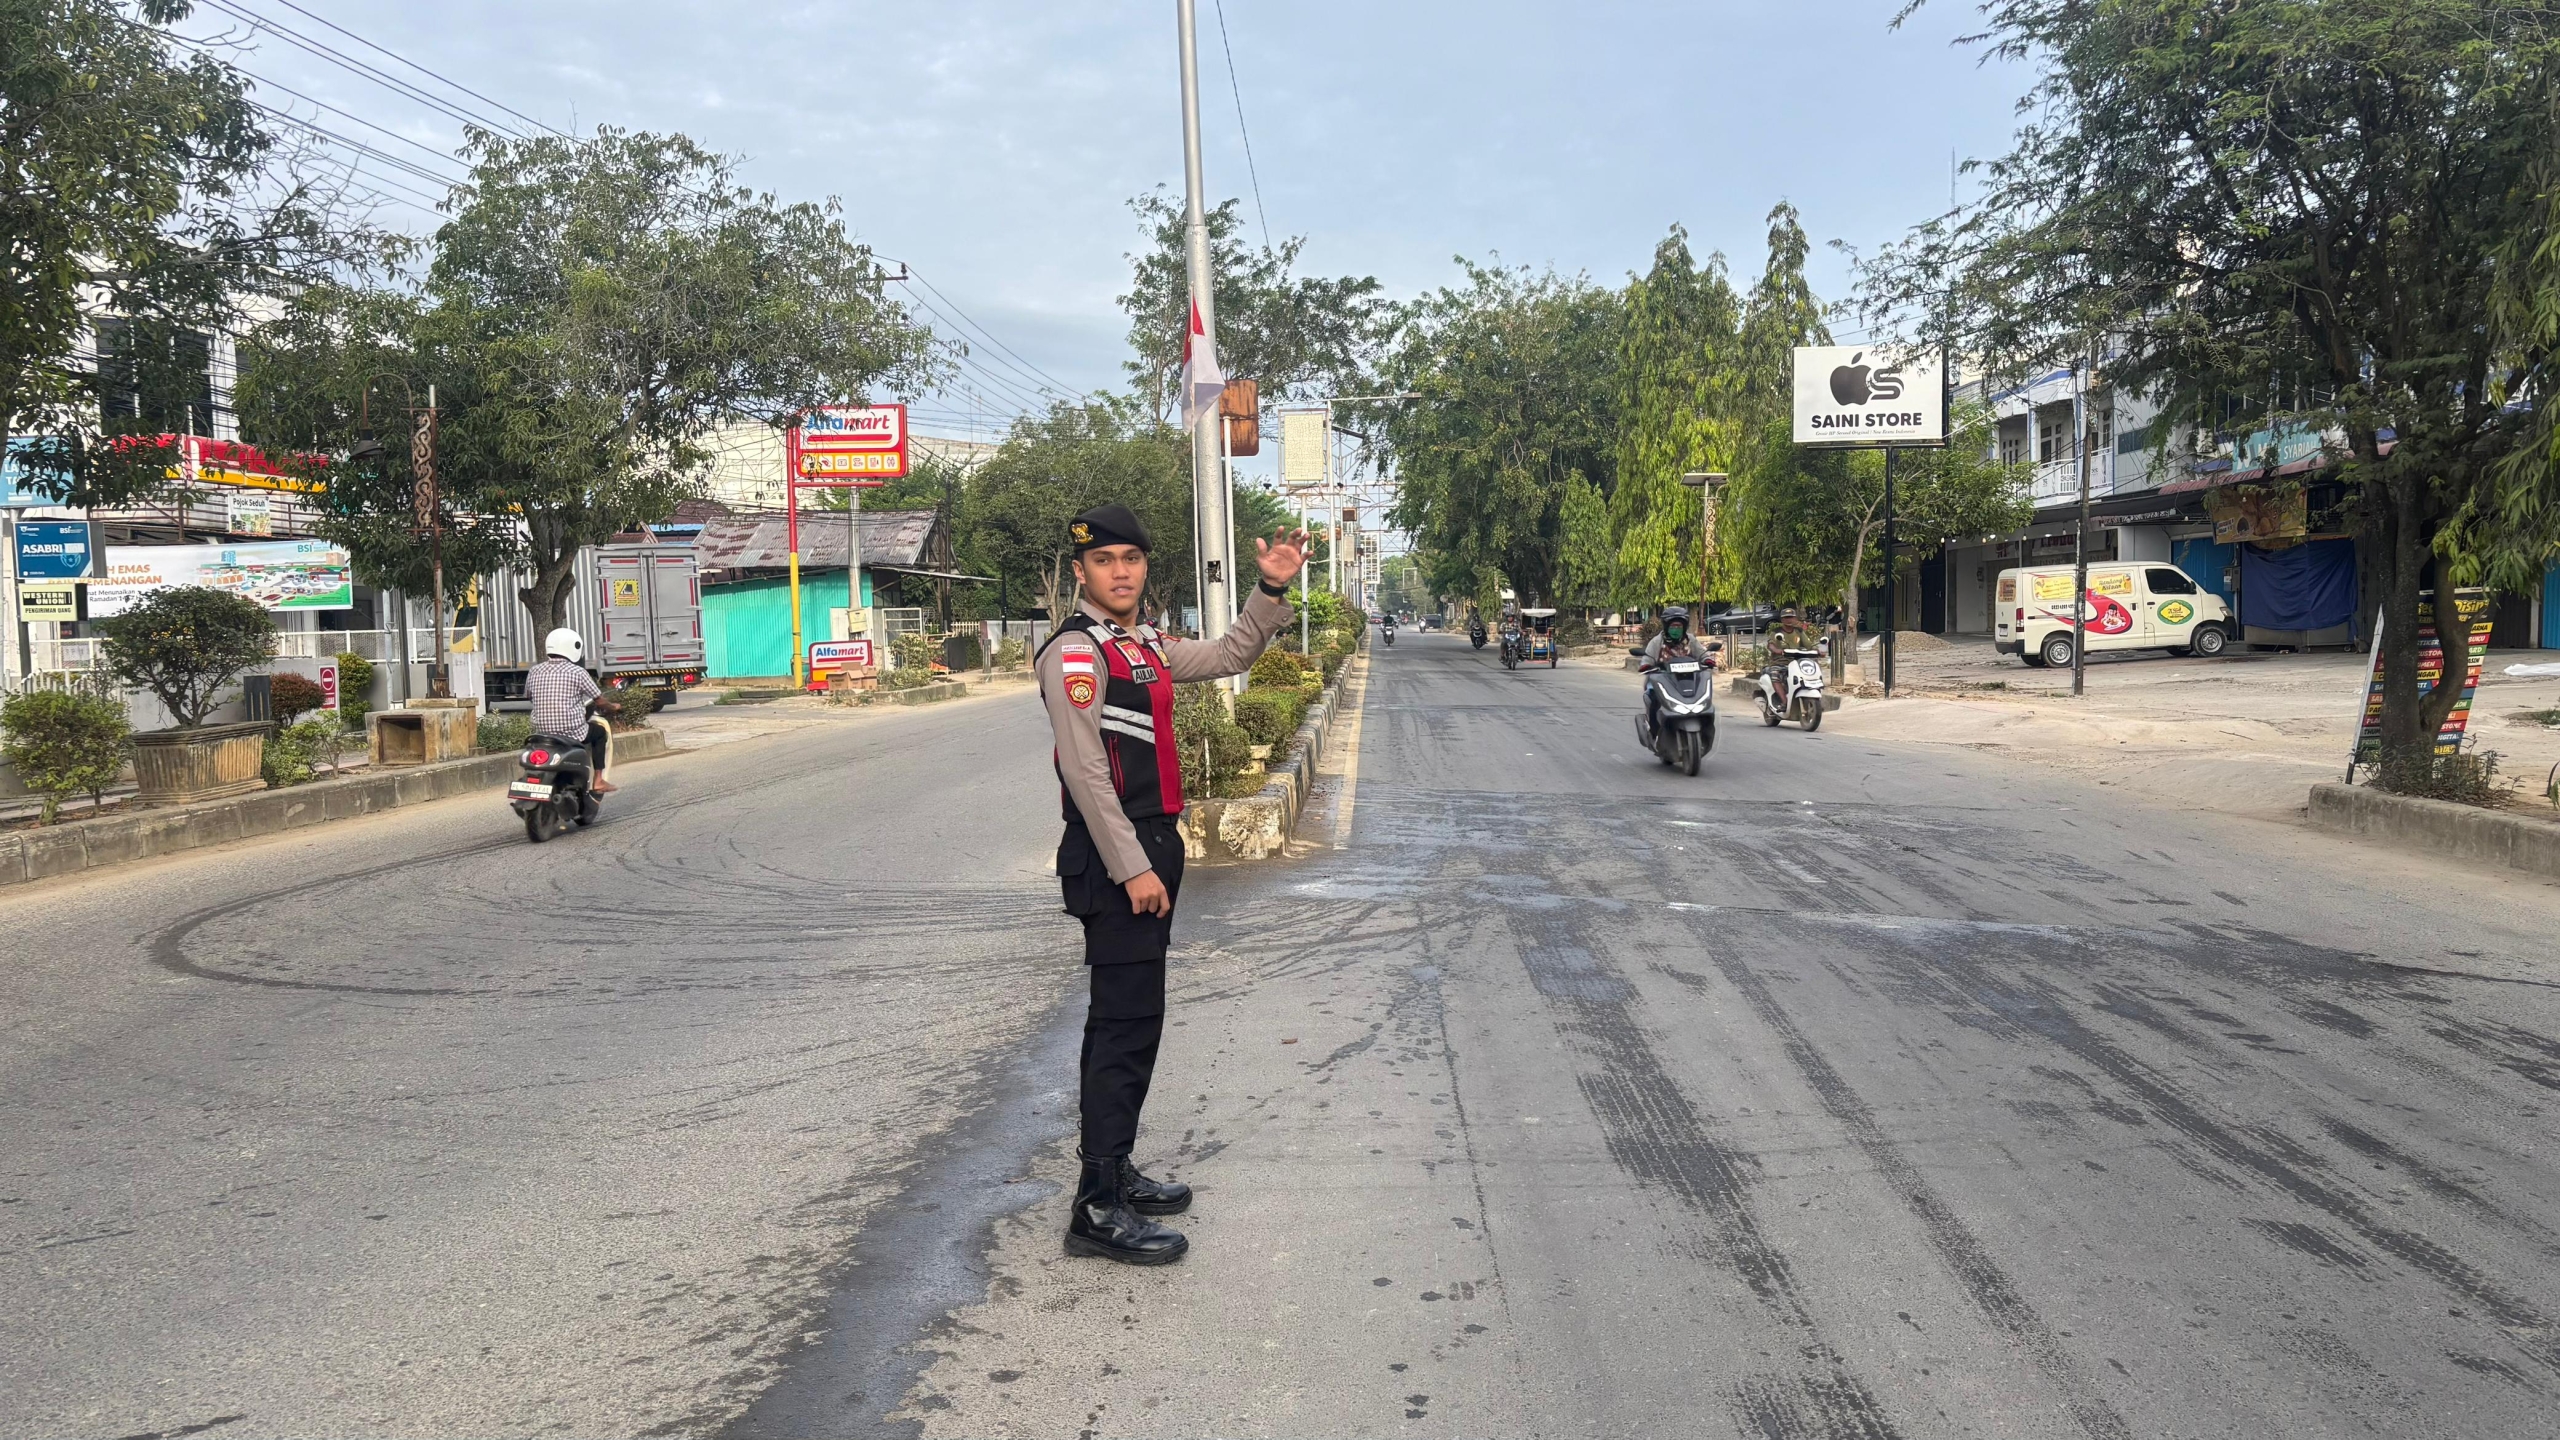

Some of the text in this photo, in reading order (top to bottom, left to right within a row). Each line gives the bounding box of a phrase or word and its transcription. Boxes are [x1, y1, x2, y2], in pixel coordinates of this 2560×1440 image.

[1811, 412, 1922, 428] SAINI STORE
[233, 498, 266, 507] Pojok Seduh
[22, 544, 63, 554] ASABRI
[297, 543, 313, 553] BSI
[118, 564, 151, 574] EMAS
[815, 646, 864, 657] Alfamart
